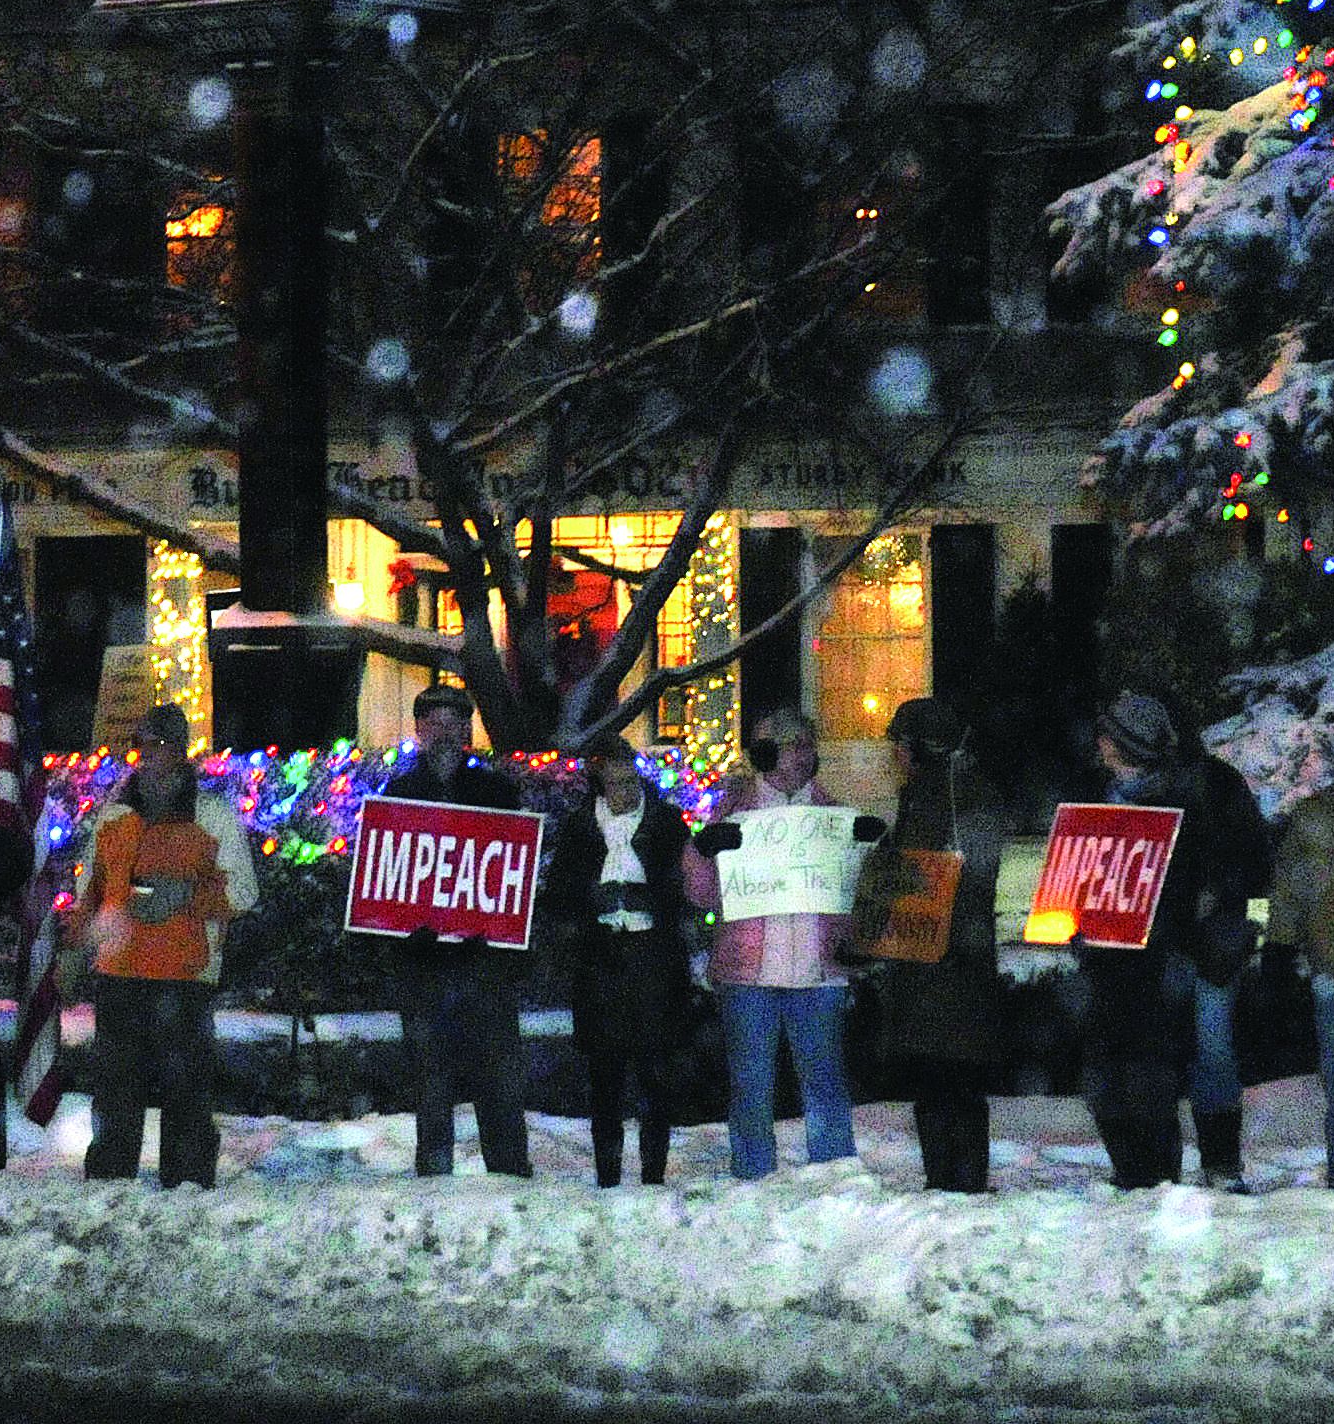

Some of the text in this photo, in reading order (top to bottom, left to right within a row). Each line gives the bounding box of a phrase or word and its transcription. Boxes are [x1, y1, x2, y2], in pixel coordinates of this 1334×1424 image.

[748, 812, 845, 847] NO ONE
[361, 828, 529, 916] IMPEACH
[1034, 835, 1166, 914] IMPEACH
